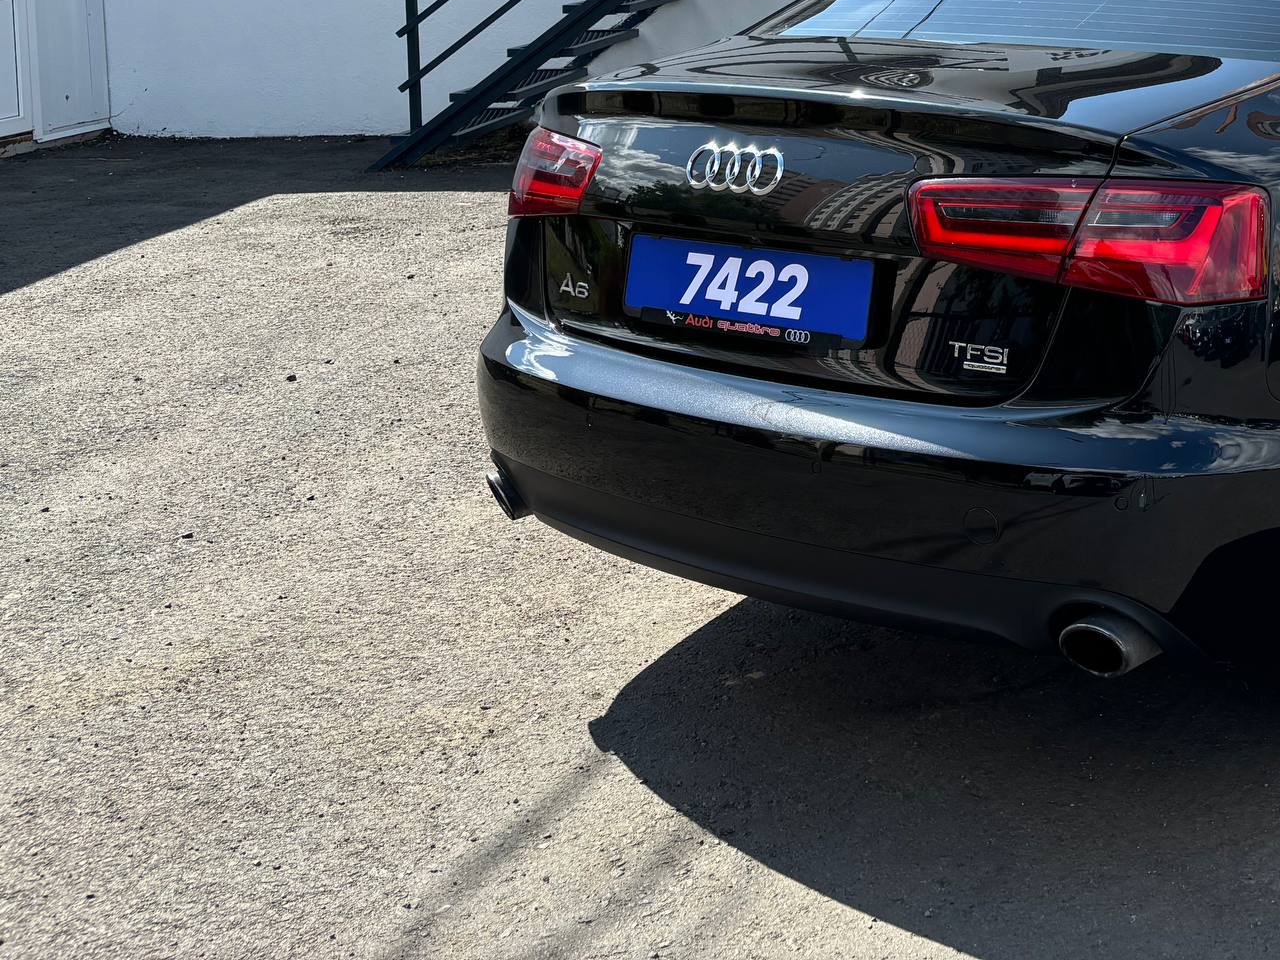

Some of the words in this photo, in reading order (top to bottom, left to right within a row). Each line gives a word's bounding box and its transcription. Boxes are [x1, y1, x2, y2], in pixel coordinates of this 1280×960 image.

[559, 272, 589, 298] A6
[679, 251, 809, 321] 7422
[685, 313, 713, 328] Audi
[717, 320, 781, 337] quattro
[949, 341, 1009, 365] TFSI
